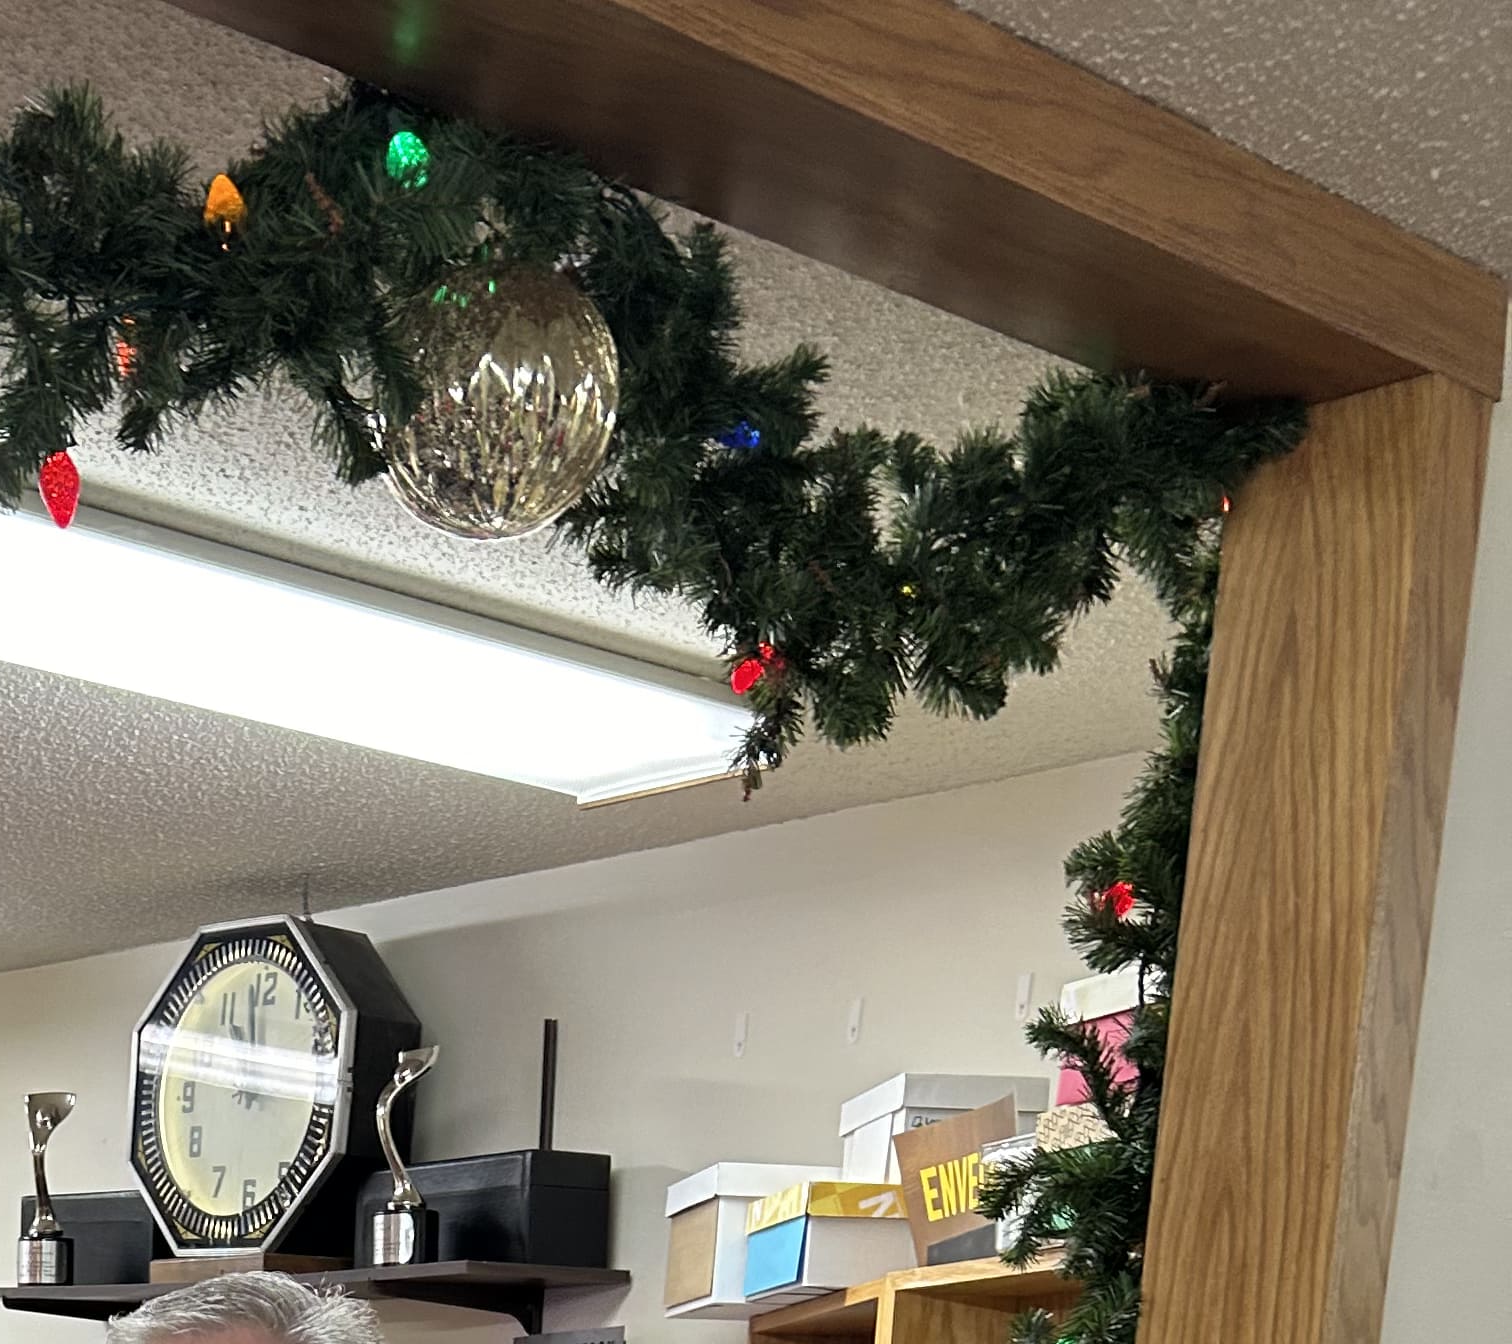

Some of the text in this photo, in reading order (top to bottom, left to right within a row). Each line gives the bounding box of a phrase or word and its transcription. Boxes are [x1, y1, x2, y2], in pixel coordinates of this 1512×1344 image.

[252, 972, 278, 1007] 12
[220, 991, 236, 1025] 11
[182, 1081, 195, 1113] 9
[189, 1126, 203, 1157] 8
[212, 1166, 226, 1198] 7
[242, 1179, 257, 1210] 6
